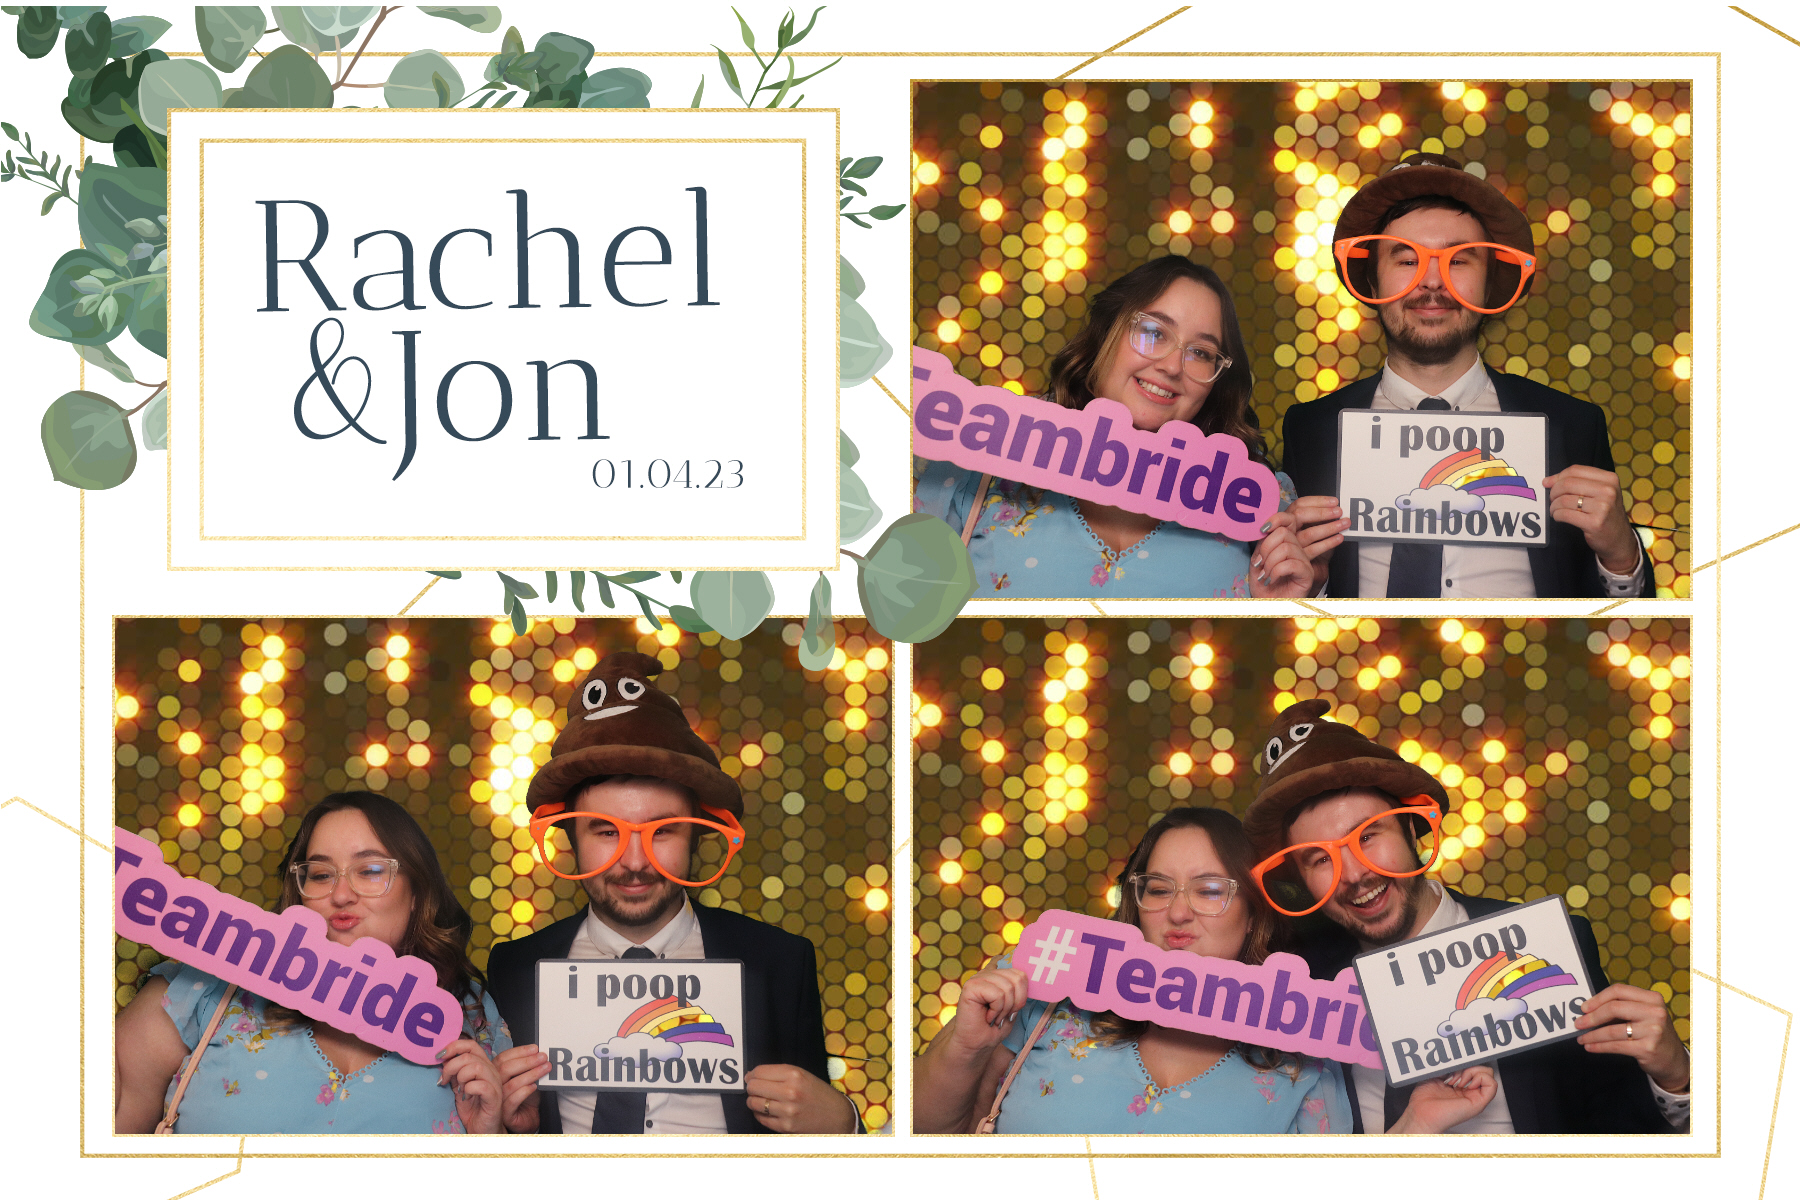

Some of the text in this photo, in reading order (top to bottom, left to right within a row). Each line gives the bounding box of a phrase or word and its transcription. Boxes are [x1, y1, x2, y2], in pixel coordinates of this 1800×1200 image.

[913, 366, 1262, 523] eambride
[1371, 415, 1505, 461] i poop
[1349, 497, 1542, 538] Rainbows
[1387, 923, 1527, 987] i poop
[568, 965, 701, 1007] i poop
[548, 1047, 740, 1085] Rainbows
